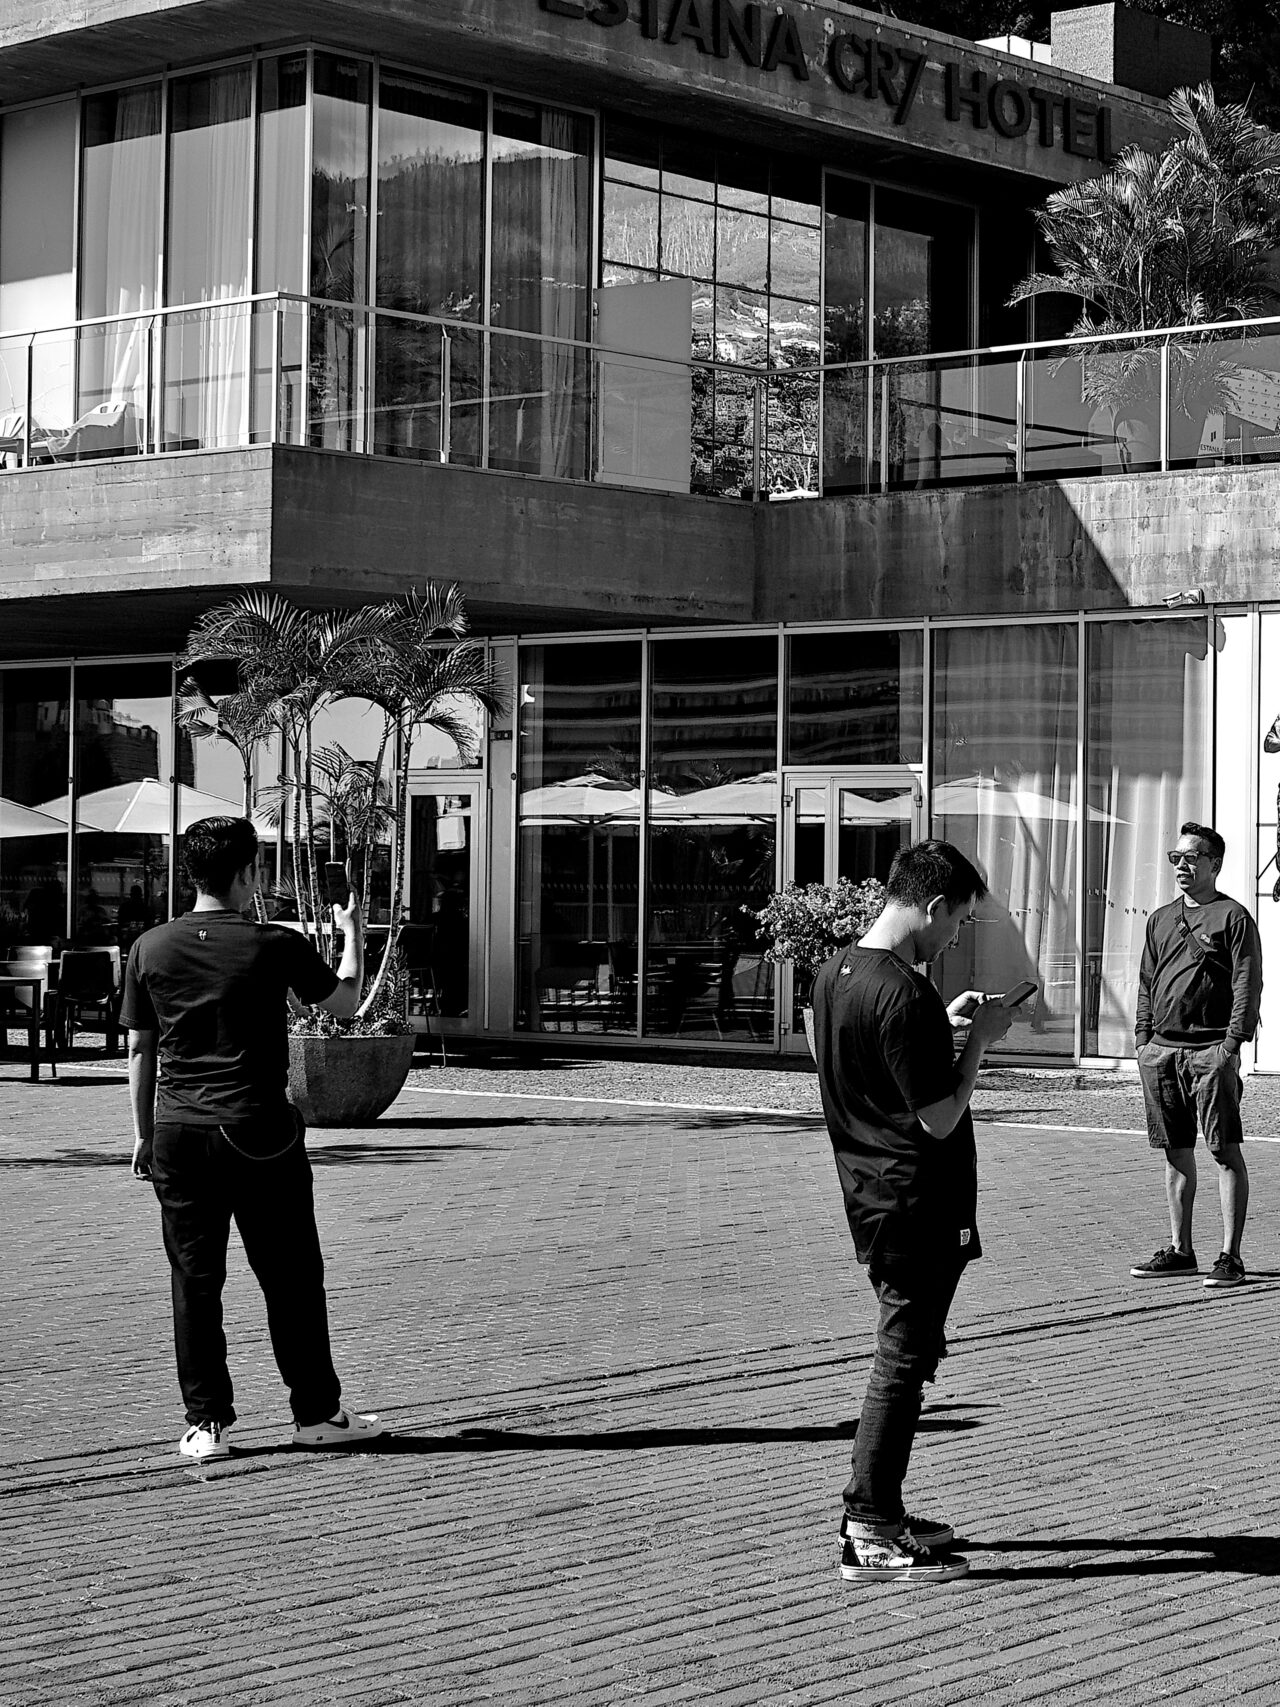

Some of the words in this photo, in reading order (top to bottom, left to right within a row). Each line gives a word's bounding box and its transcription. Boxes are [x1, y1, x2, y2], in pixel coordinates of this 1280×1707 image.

[538, 0, 809, 81] TANA
[828, 33, 928, 125] CR7
[945, 62, 1115, 164] HOTEL
